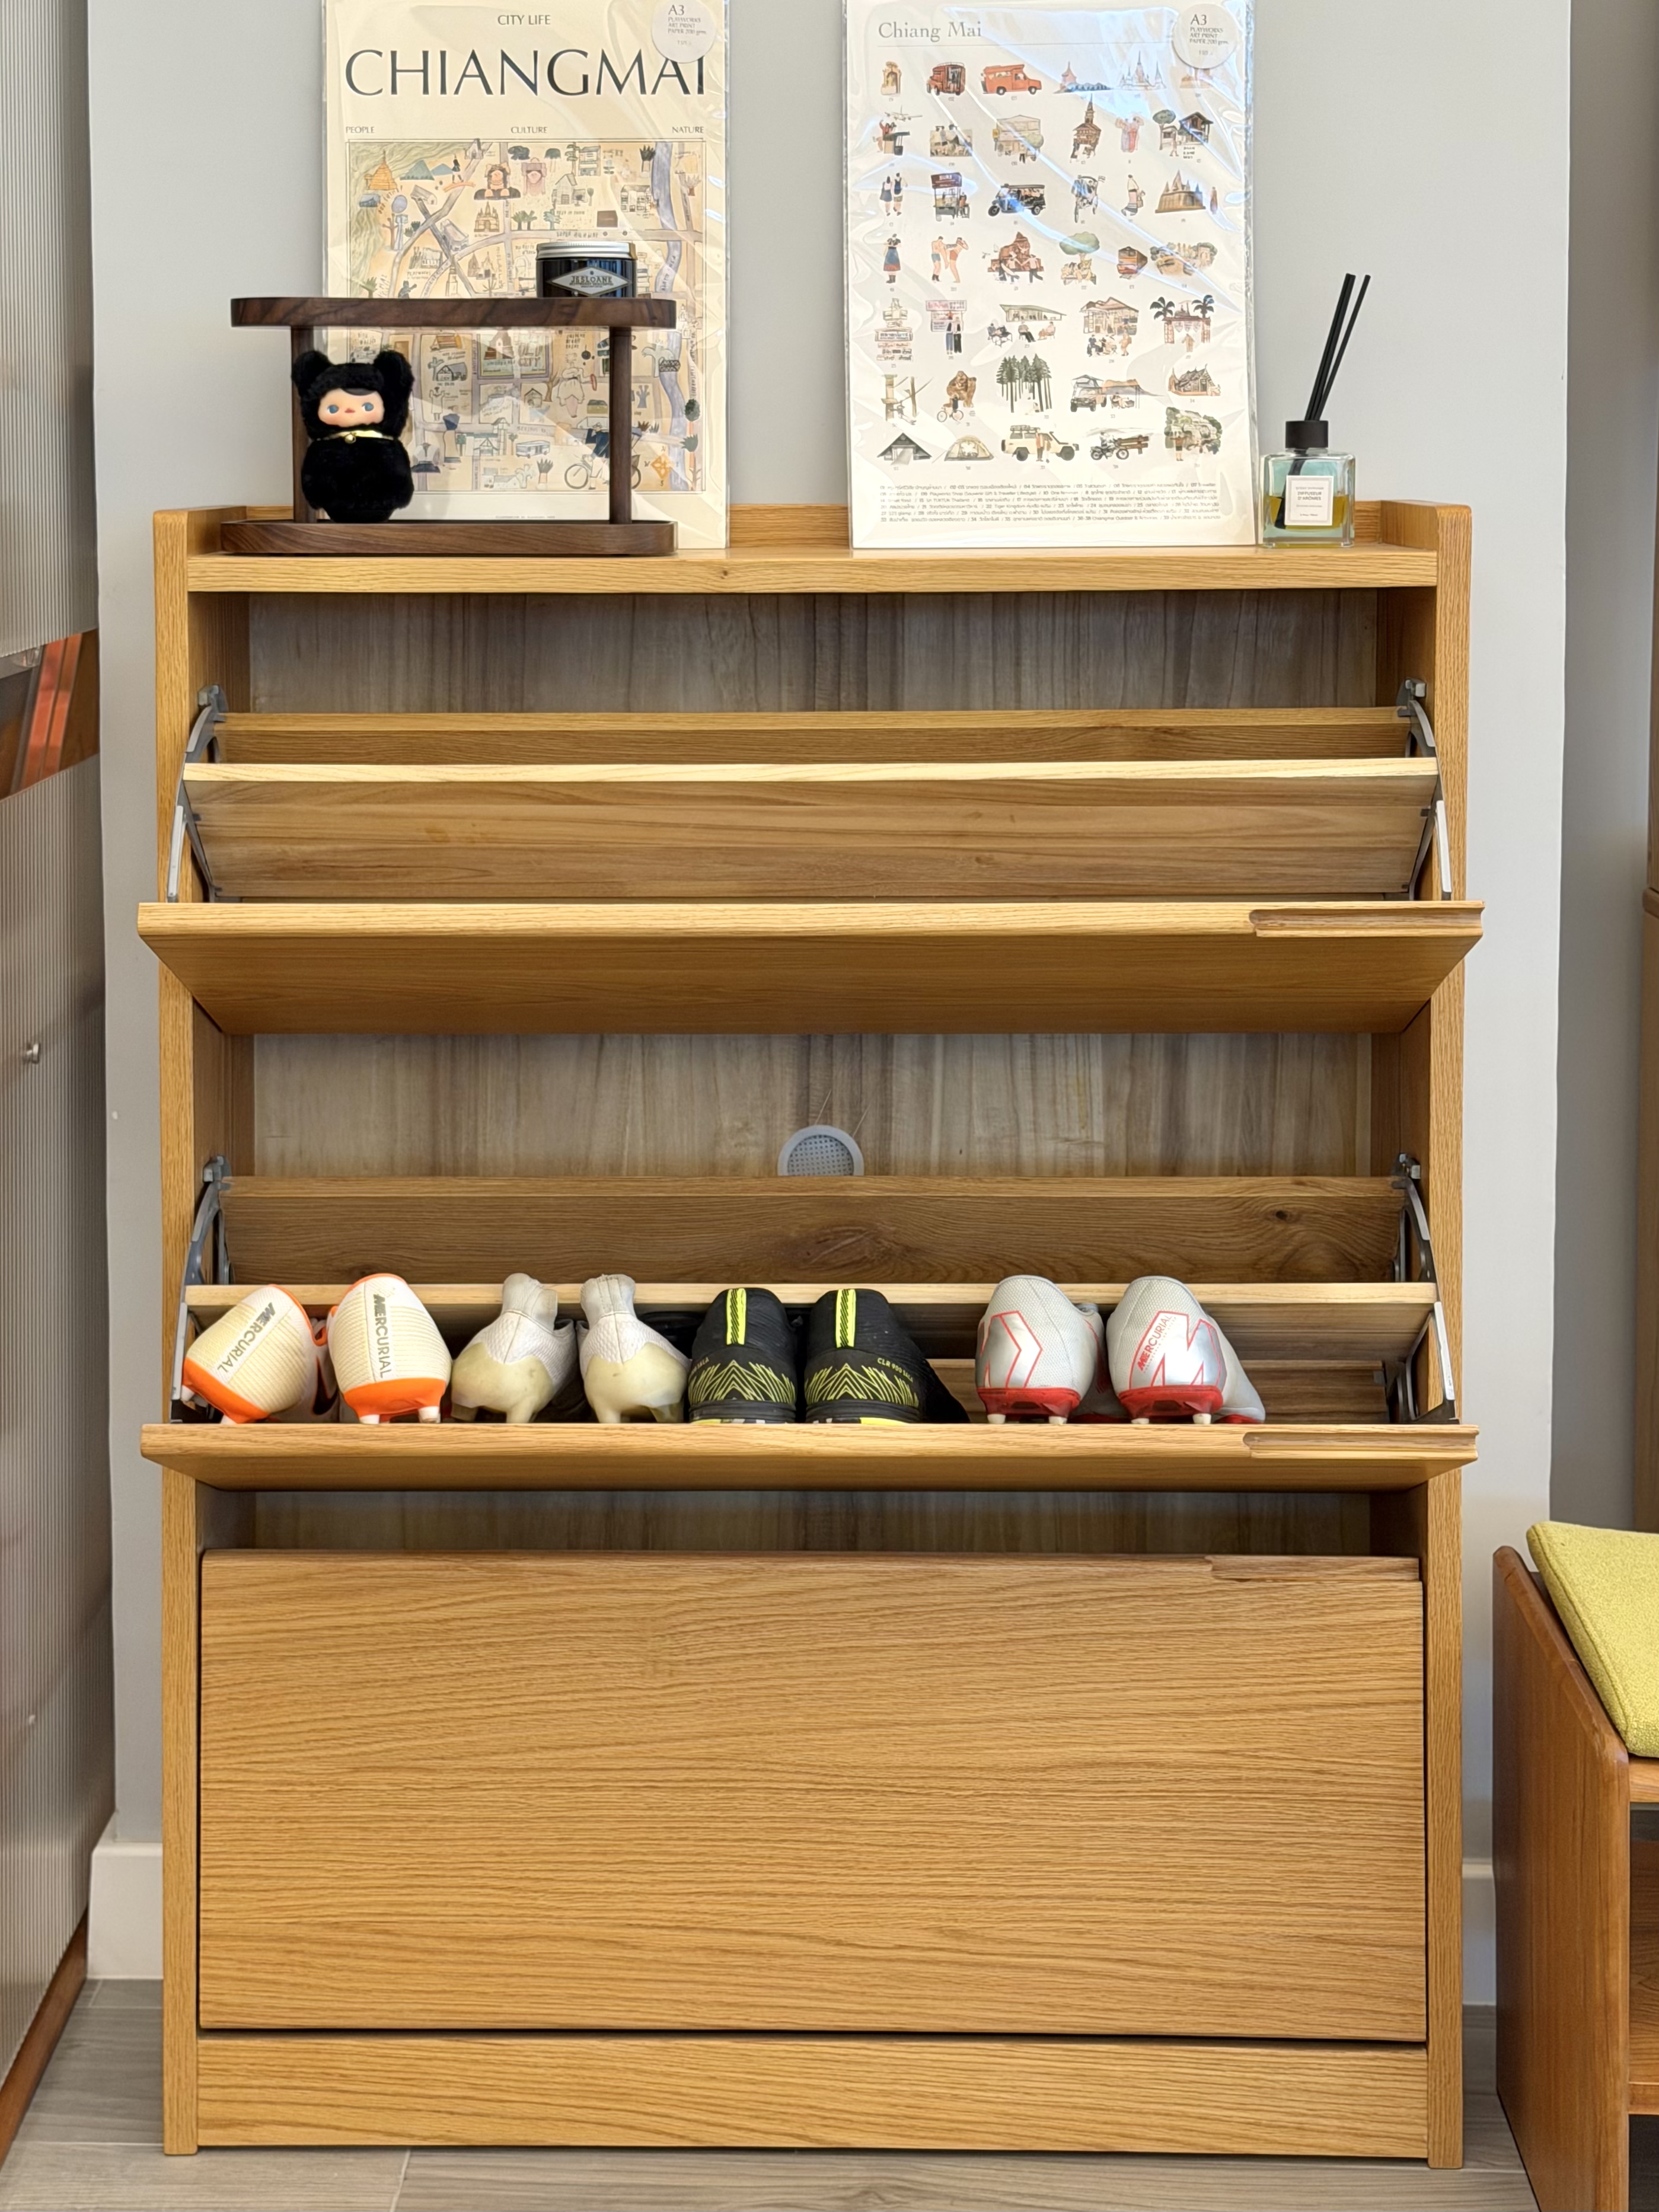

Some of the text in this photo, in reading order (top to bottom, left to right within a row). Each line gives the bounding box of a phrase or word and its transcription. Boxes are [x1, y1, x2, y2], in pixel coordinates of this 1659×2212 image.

[668, 4, 685, 15] A3
[497, 14, 551, 26] CITY LIFE
[1190, 14, 1207, 25] A3
[878, 21, 982, 42] Chiang Mai
[345, 49, 705, 96] CHIANGMAI
[346, 125, 375, 134] PEOPLE
[511, 125, 548, 134] CULTURE
[672, 125, 704, 134] NATURE
[216, 1301, 276, 1373] MERCURIAL
[372, 1293, 394, 1378] MERCURIAL
[1137, 1314, 1173, 1372] MERCURIAL
[877, 1357, 891, 1368] CLR
